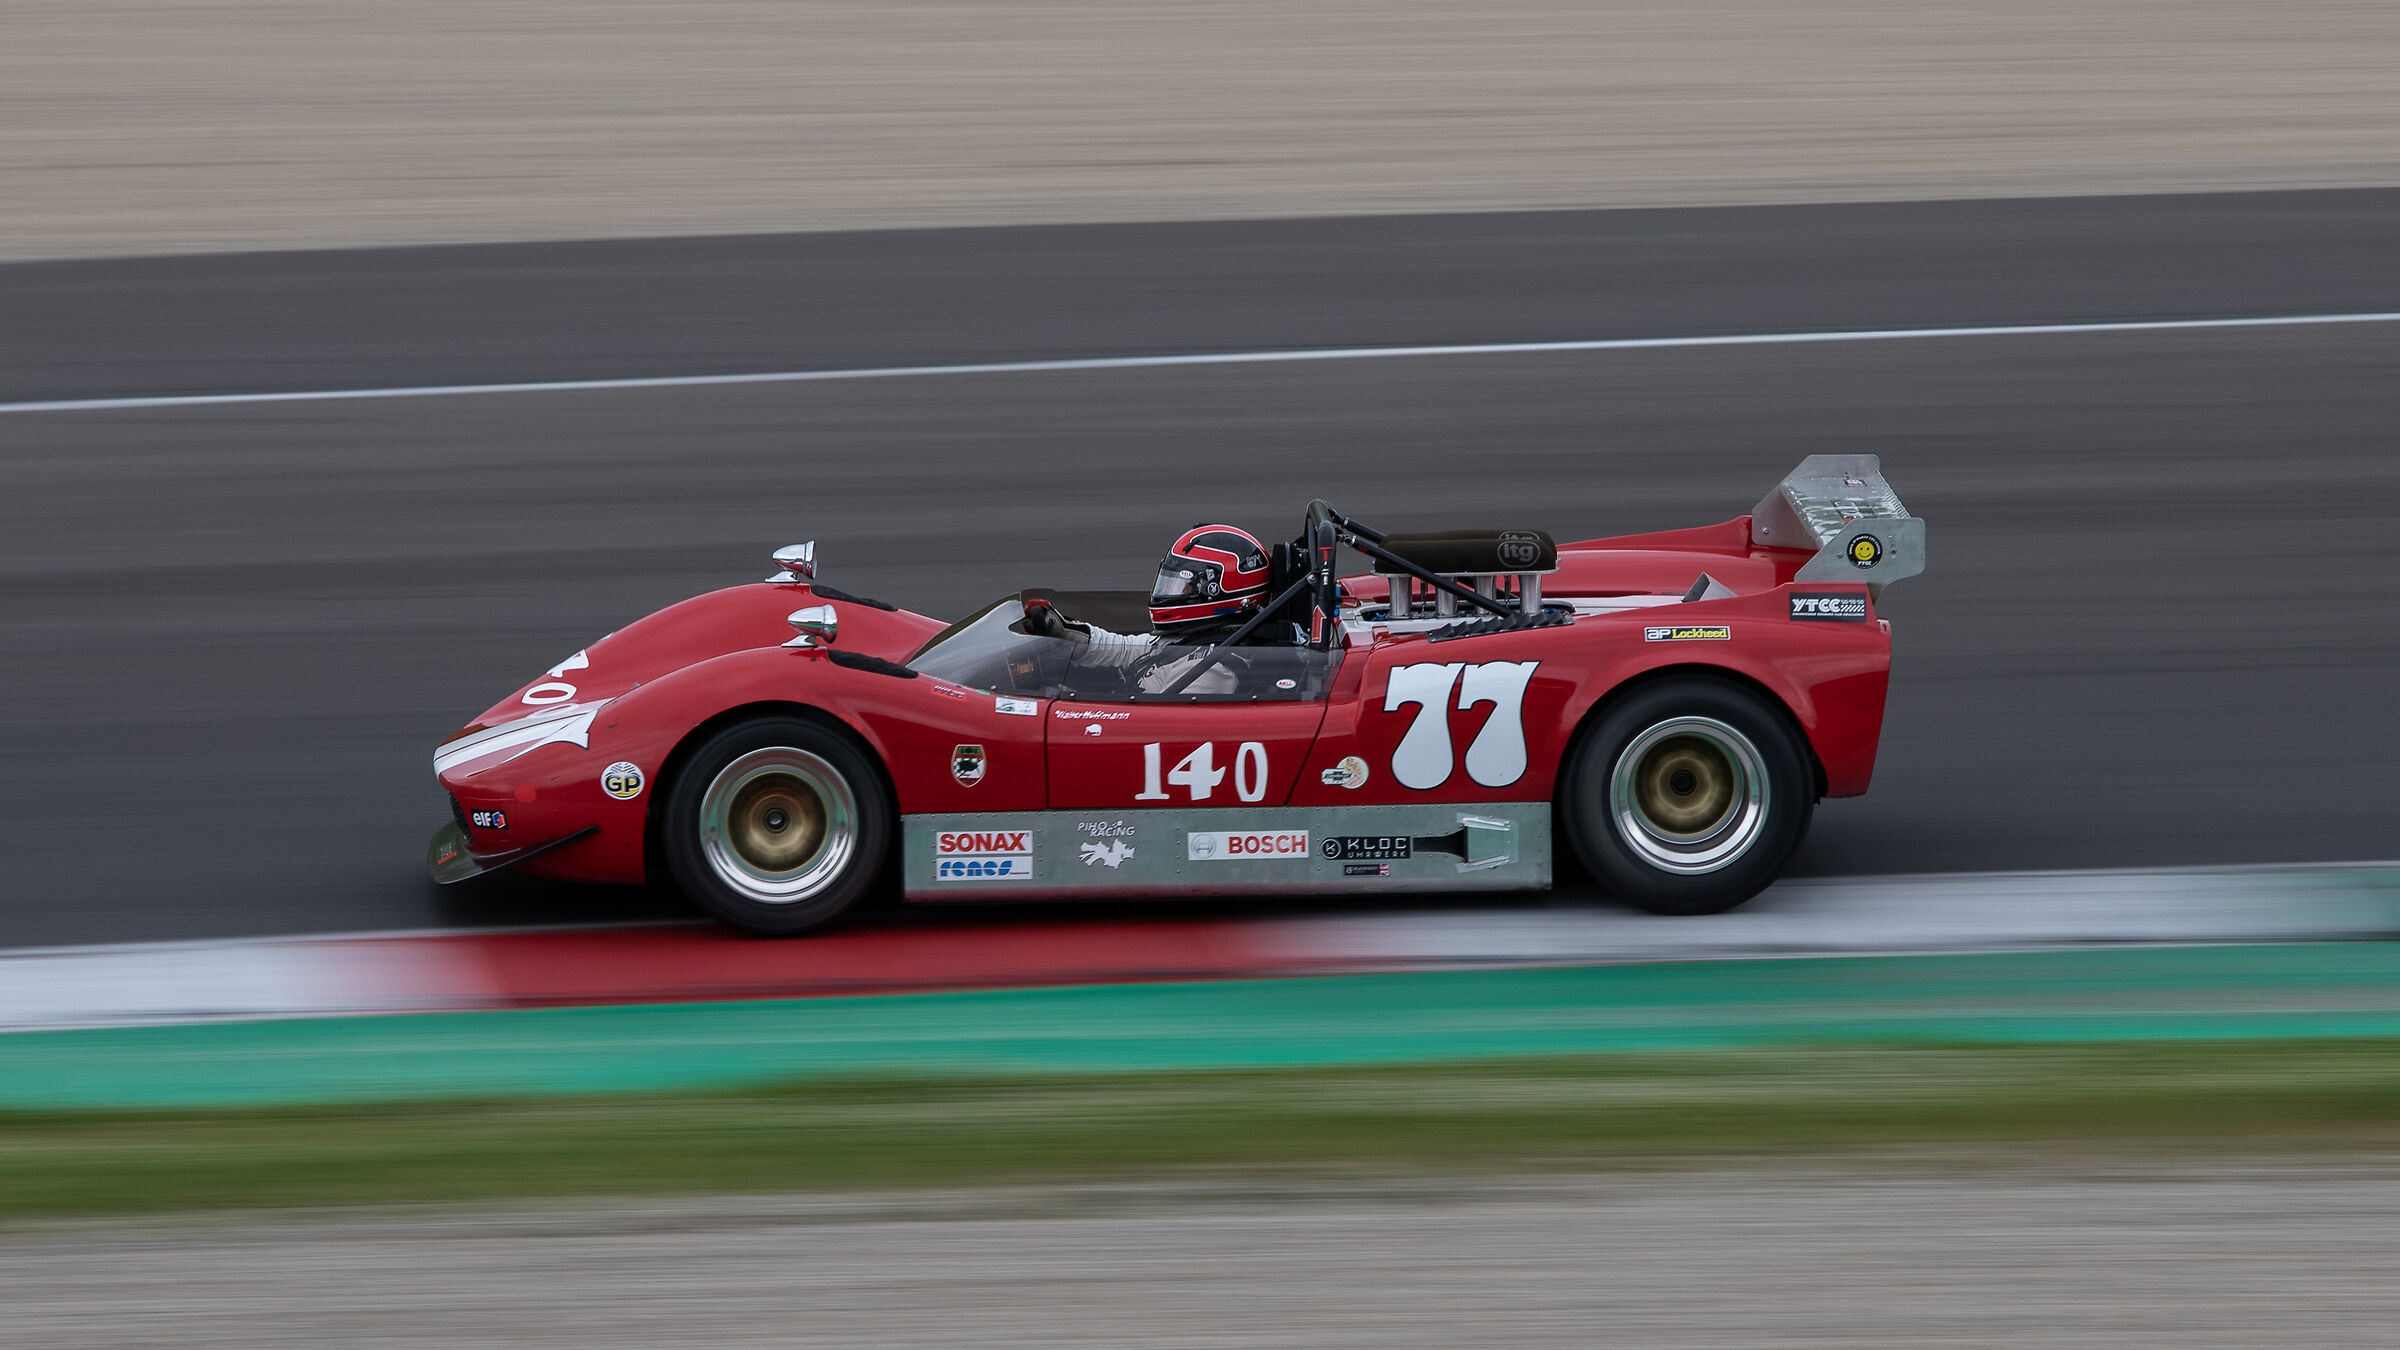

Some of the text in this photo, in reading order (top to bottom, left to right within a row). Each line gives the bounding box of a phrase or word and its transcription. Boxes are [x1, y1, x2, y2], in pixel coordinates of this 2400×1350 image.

[1792, 598, 1840, 612] YTCC
[1671, 628, 1728, 639] Lockheed
[1384, 660, 1541, 791] 77
[1134, 741, 1269, 802] 140
[605, 775, 641, 793] GP
[473, 812, 491, 827] elf
[1077, 821, 1108, 833] PIHO
[1089, 826, 1136, 837] RACING
[940, 833, 1026, 853] SONAX
[1228, 835, 1306, 854] BOSCH
[1347, 838, 1407, 850] KLOC
